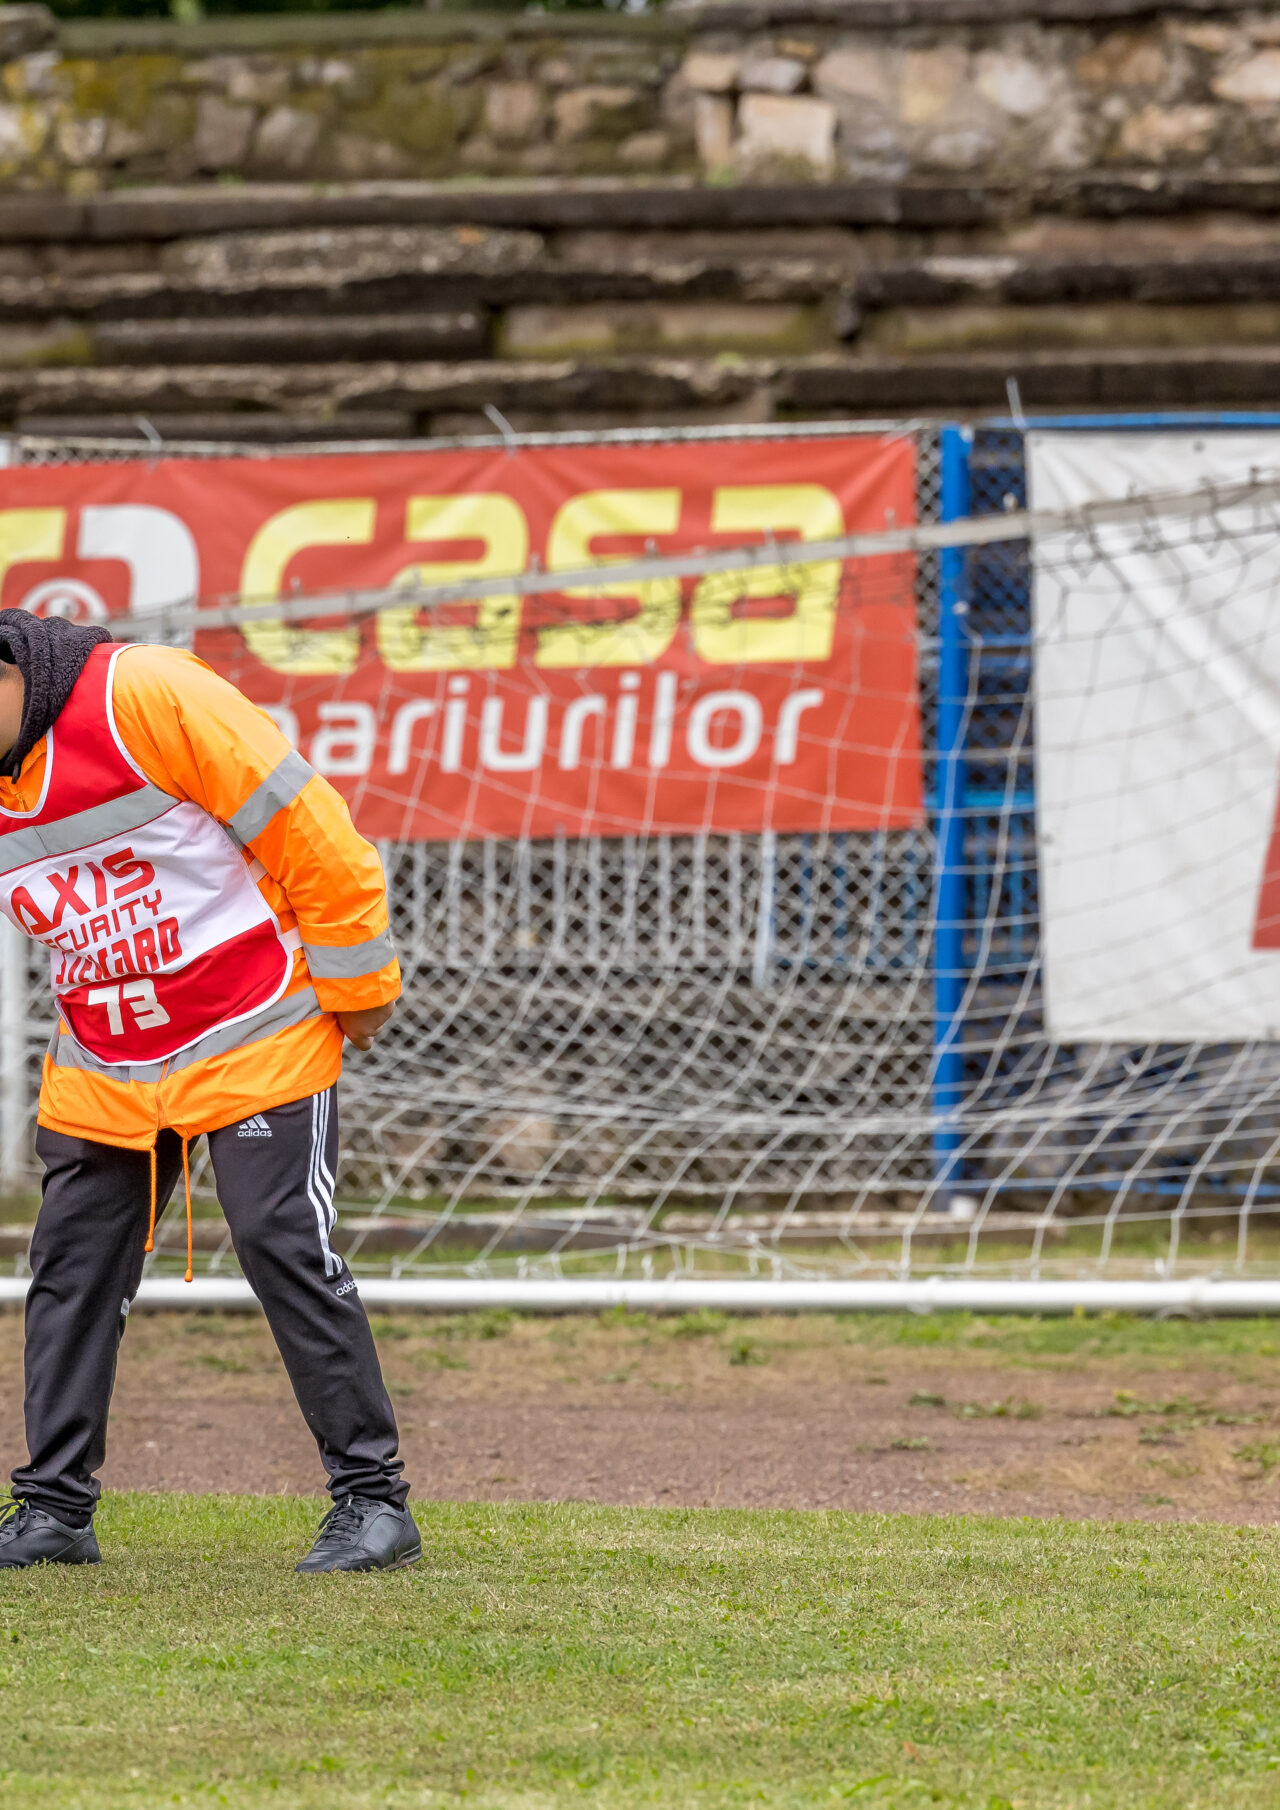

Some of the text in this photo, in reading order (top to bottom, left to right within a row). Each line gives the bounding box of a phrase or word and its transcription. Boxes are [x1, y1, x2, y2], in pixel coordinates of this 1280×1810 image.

[240, 485, 846, 676] casa
[256, 672, 824, 776] ariurilor
[11, 847, 156, 936] AXIS
[38, 889, 163, 953] ECURITY
[87, 978, 171, 1036] 73
[237, 1128, 273, 1138] adidas
